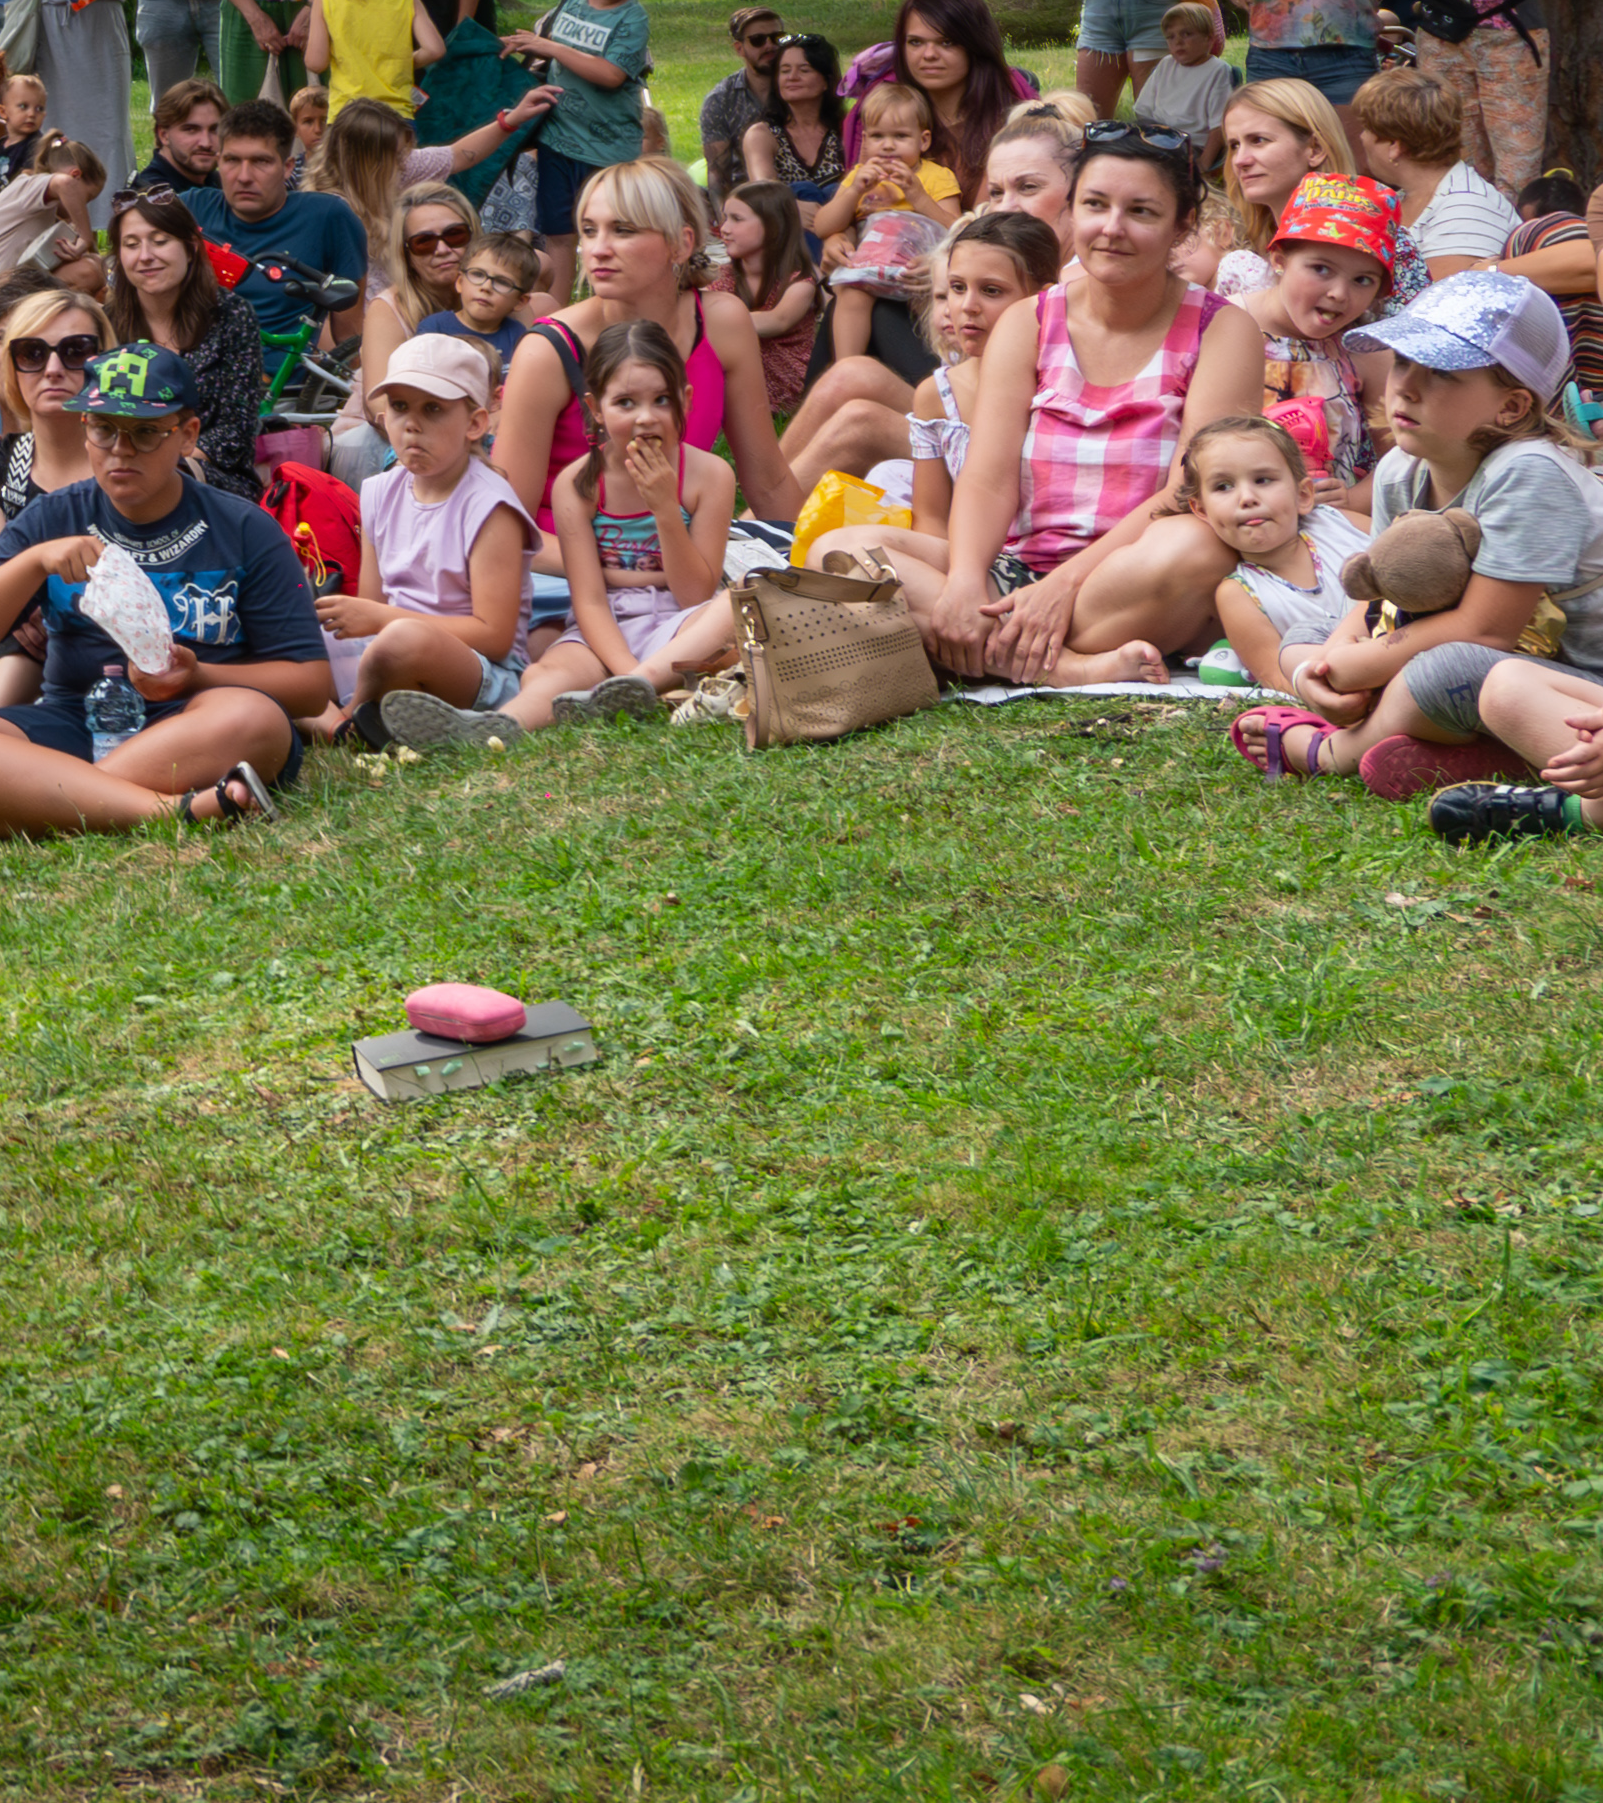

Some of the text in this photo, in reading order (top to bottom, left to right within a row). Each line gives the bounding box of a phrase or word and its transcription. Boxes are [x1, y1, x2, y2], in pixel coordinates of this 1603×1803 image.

[557, 16, 607, 46] TOKYO
[147, 552, 160, 563] &
[159, 518, 210, 560] WIZARDRY
